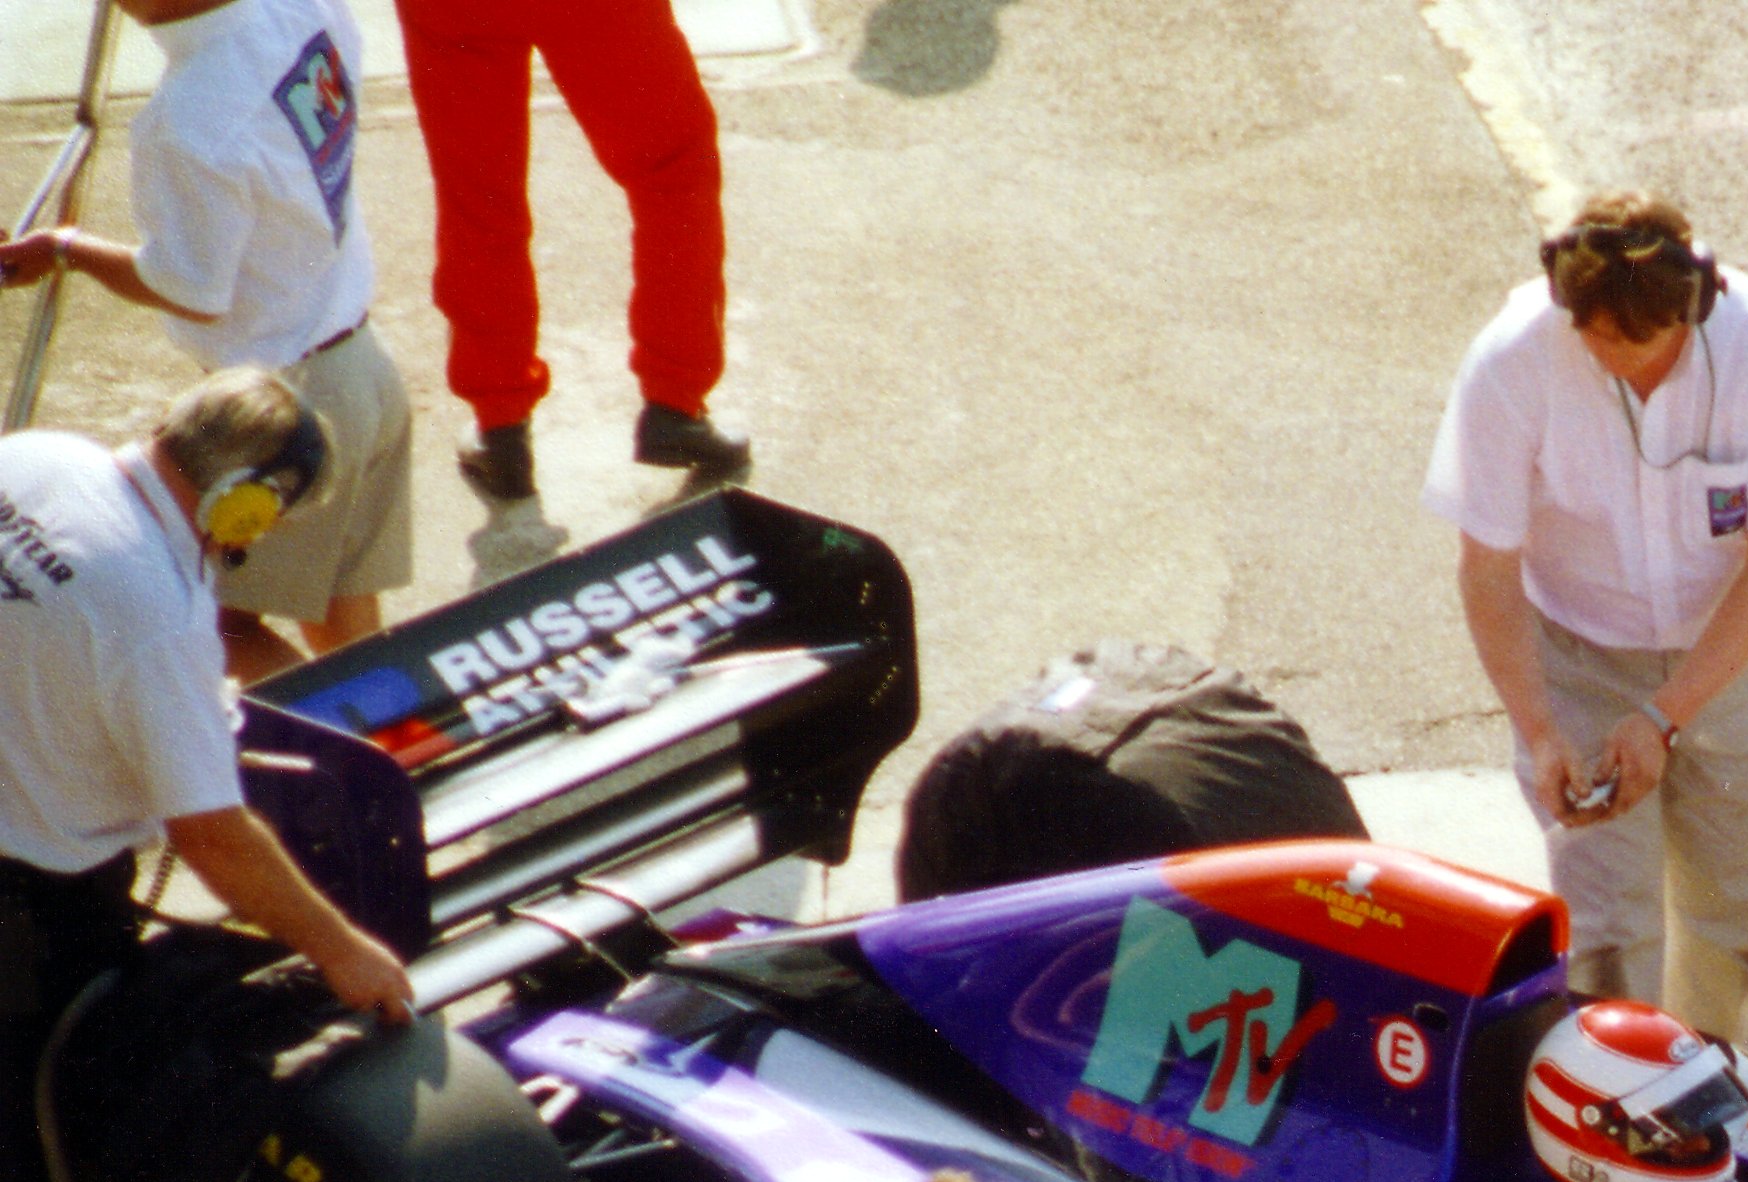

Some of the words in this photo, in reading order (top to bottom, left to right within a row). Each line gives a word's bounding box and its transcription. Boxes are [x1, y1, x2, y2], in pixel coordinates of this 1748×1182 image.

[428, 535, 757, 695] RUSSELL
[1079, 893, 1338, 1148] MTV
[1389, 1029, 1413, 1074] E
